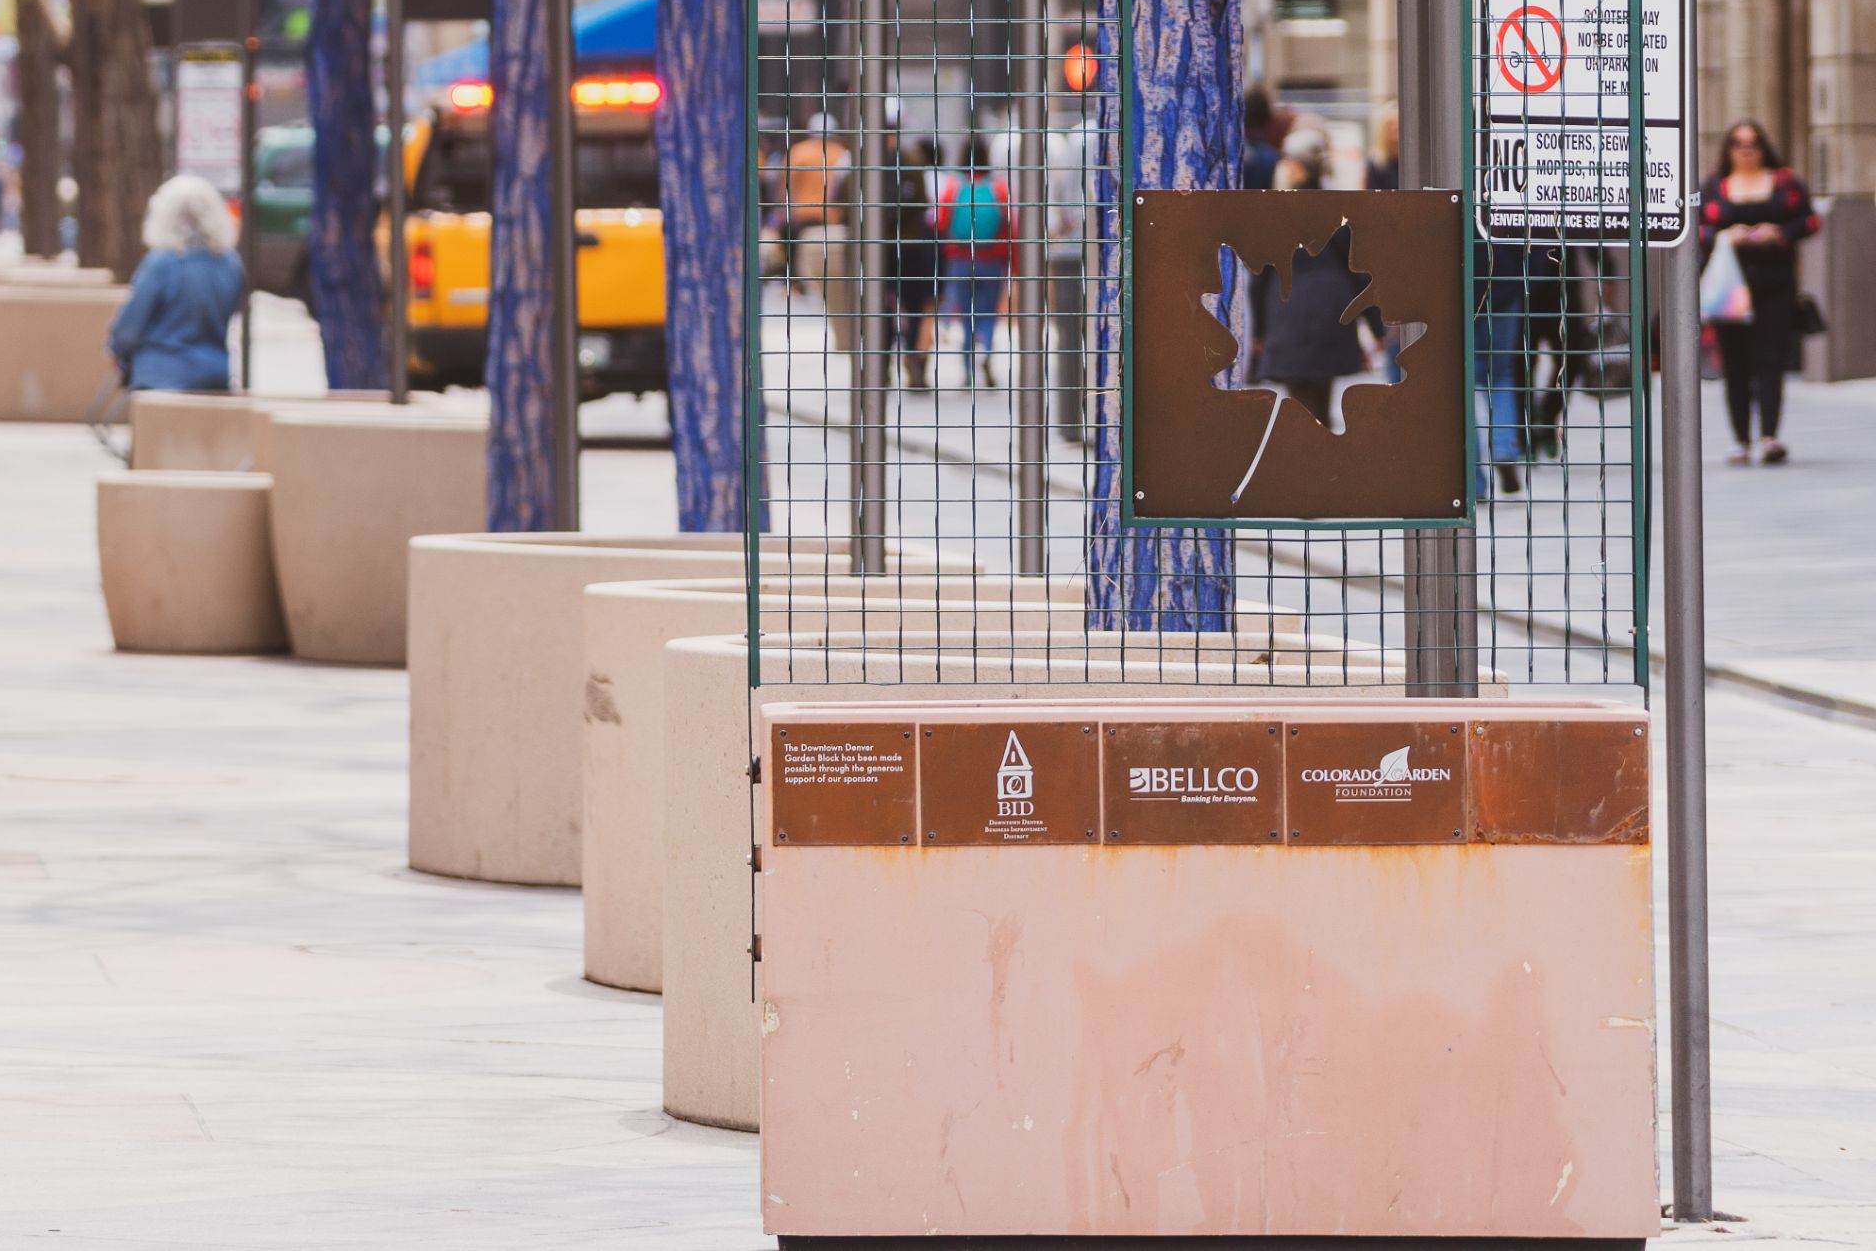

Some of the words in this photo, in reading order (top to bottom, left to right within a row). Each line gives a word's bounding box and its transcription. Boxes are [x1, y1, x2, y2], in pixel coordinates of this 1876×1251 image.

[1584, 8, 1629, 25] SCOTER
[1616, 33, 1668, 49] OPATED
[1602, 57, 1632, 72] PARK
[1645, 57, 1658, 73] ON
[1599, 134, 1651, 155] SEGWS,
[1492, 138, 1528, 193] NO
[1588, 160, 1674, 182] RLLERADES,
[784, 743, 799, 752] The
[801, 743, 843, 752] Downtown
[845, 743, 874, 752] Denver
[784, 754, 815, 763] Garden
[818, 753, 840, 762] Block
[841, 753, 856, 762] has
[857, 753, 878, 762] been
[879, 753, 903, 762] made
[784, 764, 817, 775] possible
[819, 764, 850, 775] through
[852, 764, 865, 773] the
[866, 765, 904, 775] generous
[1301, 768, 1384, 783] COLORADO
[1389, 768, 1452, 782] GARDEN
[784, 775, 815, 785] support
[817, 774, 826, 783] of
[827, 775, 841, 783] our
[843, 775, 878, 785] sponsors
[1151, 767, 1259, 793] BELLCO
[1180, 795, 1211, 804] Banking
[1212, 795, 1223, 803] for
[1224, 795, 1259, 804] Everyone.
[1335, 787, 1412, 797] FOUNDATION
[996, 800, 1035, 817] BID
